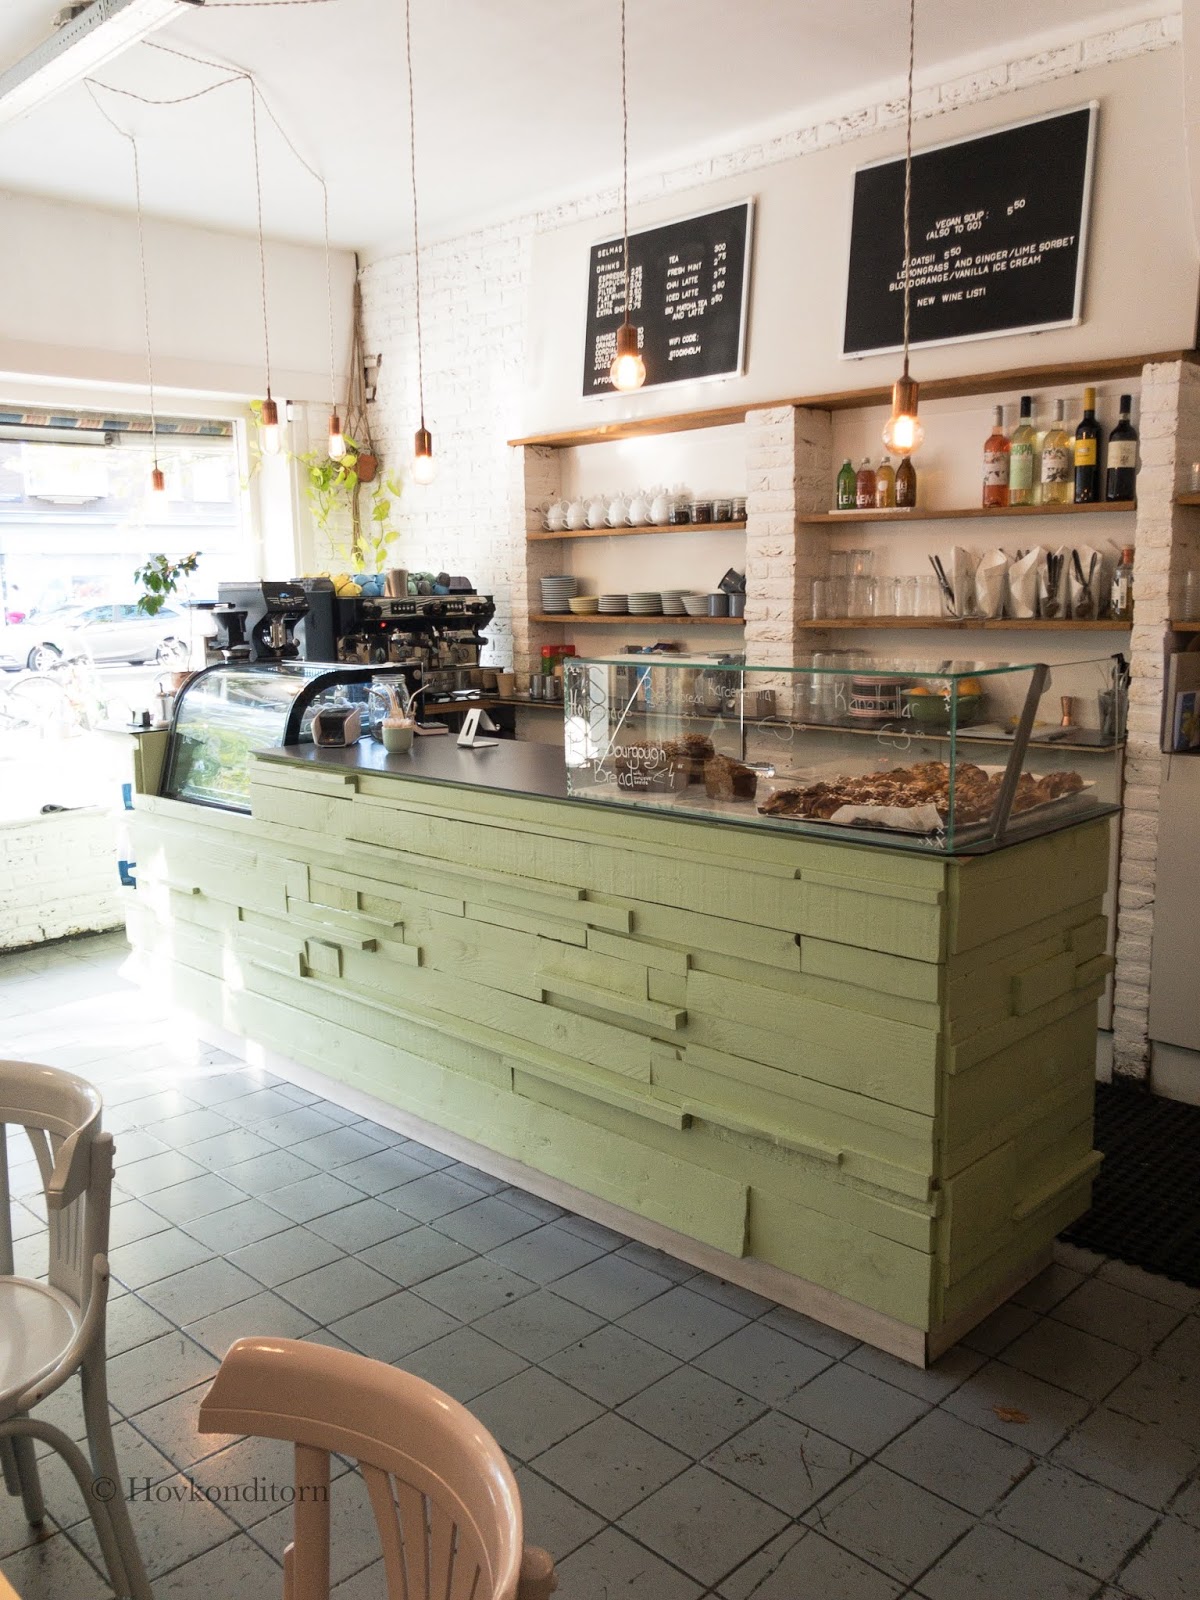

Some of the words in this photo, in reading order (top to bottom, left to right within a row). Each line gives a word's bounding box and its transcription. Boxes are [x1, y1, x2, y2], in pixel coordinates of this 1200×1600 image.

[935, 216, 961, 229] VEGAN
[926, 228, 950, 241] (ALSO
[954, 224, 964, 234] TO
[966, 221, 982, 231] GO)
[954, 257, 973, 268] AND
[1038, 236, 1075, 252] SORBET
[669, 255, 679, 264] TEA
[902, 254, 936, 268] FOATS!!
[596, 260, 620, 274] DRINKS
[667, 265, 685, 277] FRESH
[687, 262, 702, 273] MINT
[889, 265, 989, 292] BLODORANGE/VANILLA
[992, 261, 1007, 273] ICE
[1009, 255, 1042, 269] CREAM
[666, 280, 679, 290] CHAI
[681, 275, 699, 287] LATTE
[666, 292, 680, 302] ICED
[681, 288, 699, 299] LATTE
[916, 296, 936, 307] NEW
[941, 291, 963, 303] WINE
[597, 300, 613, 311] LATTE
[676, 301, 697, 312] MATCHA
[698, 299, 708, 308] TEA
[596, 309, 613, 318] EXTRA
[672, 312, 684, 321] AND
[688, 306, 704, 318] LATTE
[669, 336, 681, 346] WIFI
[594, 361, 611, 371] JUICE
[593, 759, 634, 787] Bread
